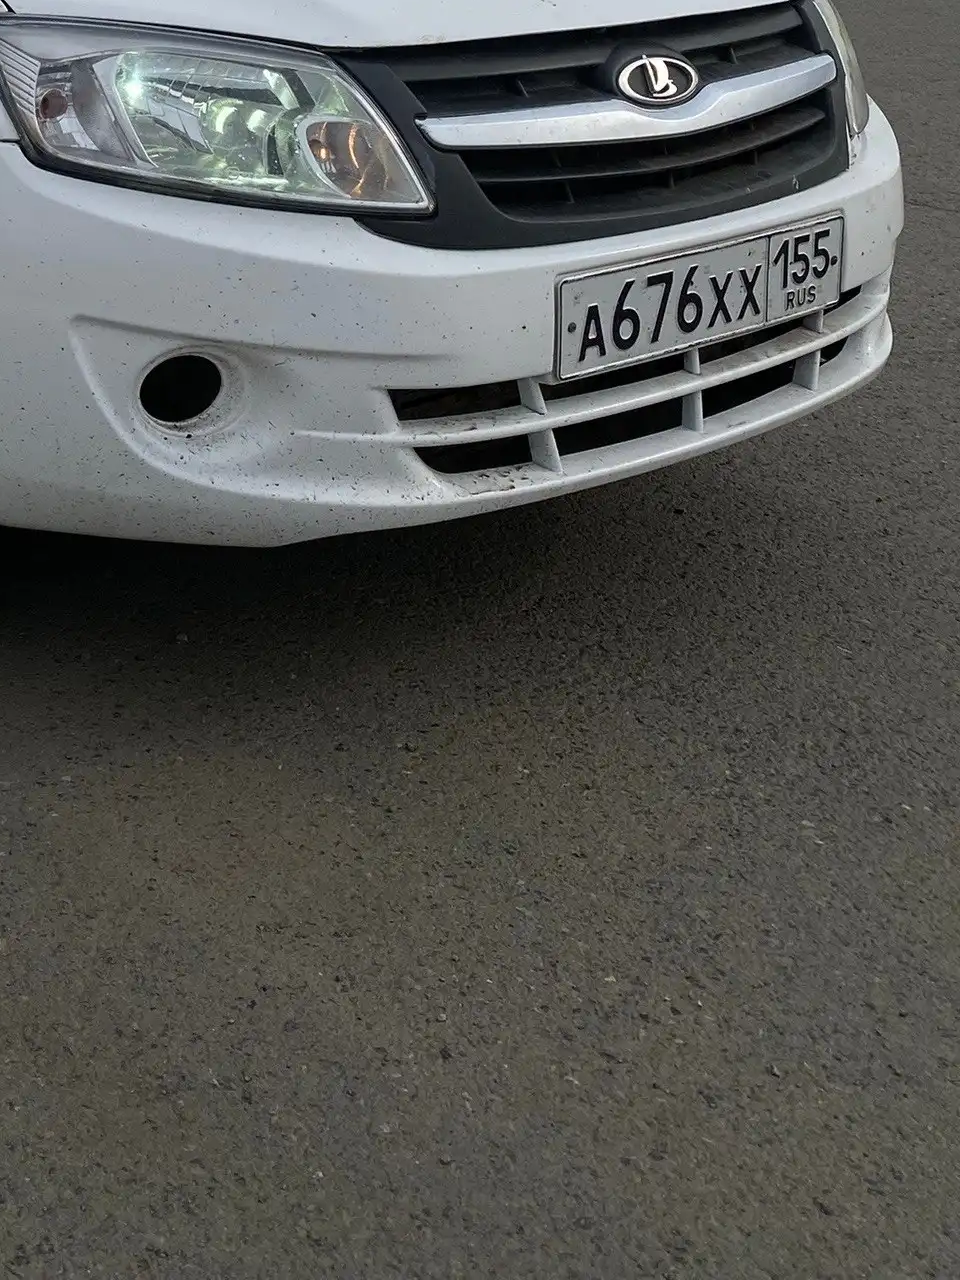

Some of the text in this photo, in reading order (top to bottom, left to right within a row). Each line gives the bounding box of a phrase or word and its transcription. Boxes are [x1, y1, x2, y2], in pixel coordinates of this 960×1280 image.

[577, 228, 832, 363] А676ХХ 155
[784, 285, 817, 312] RUS
